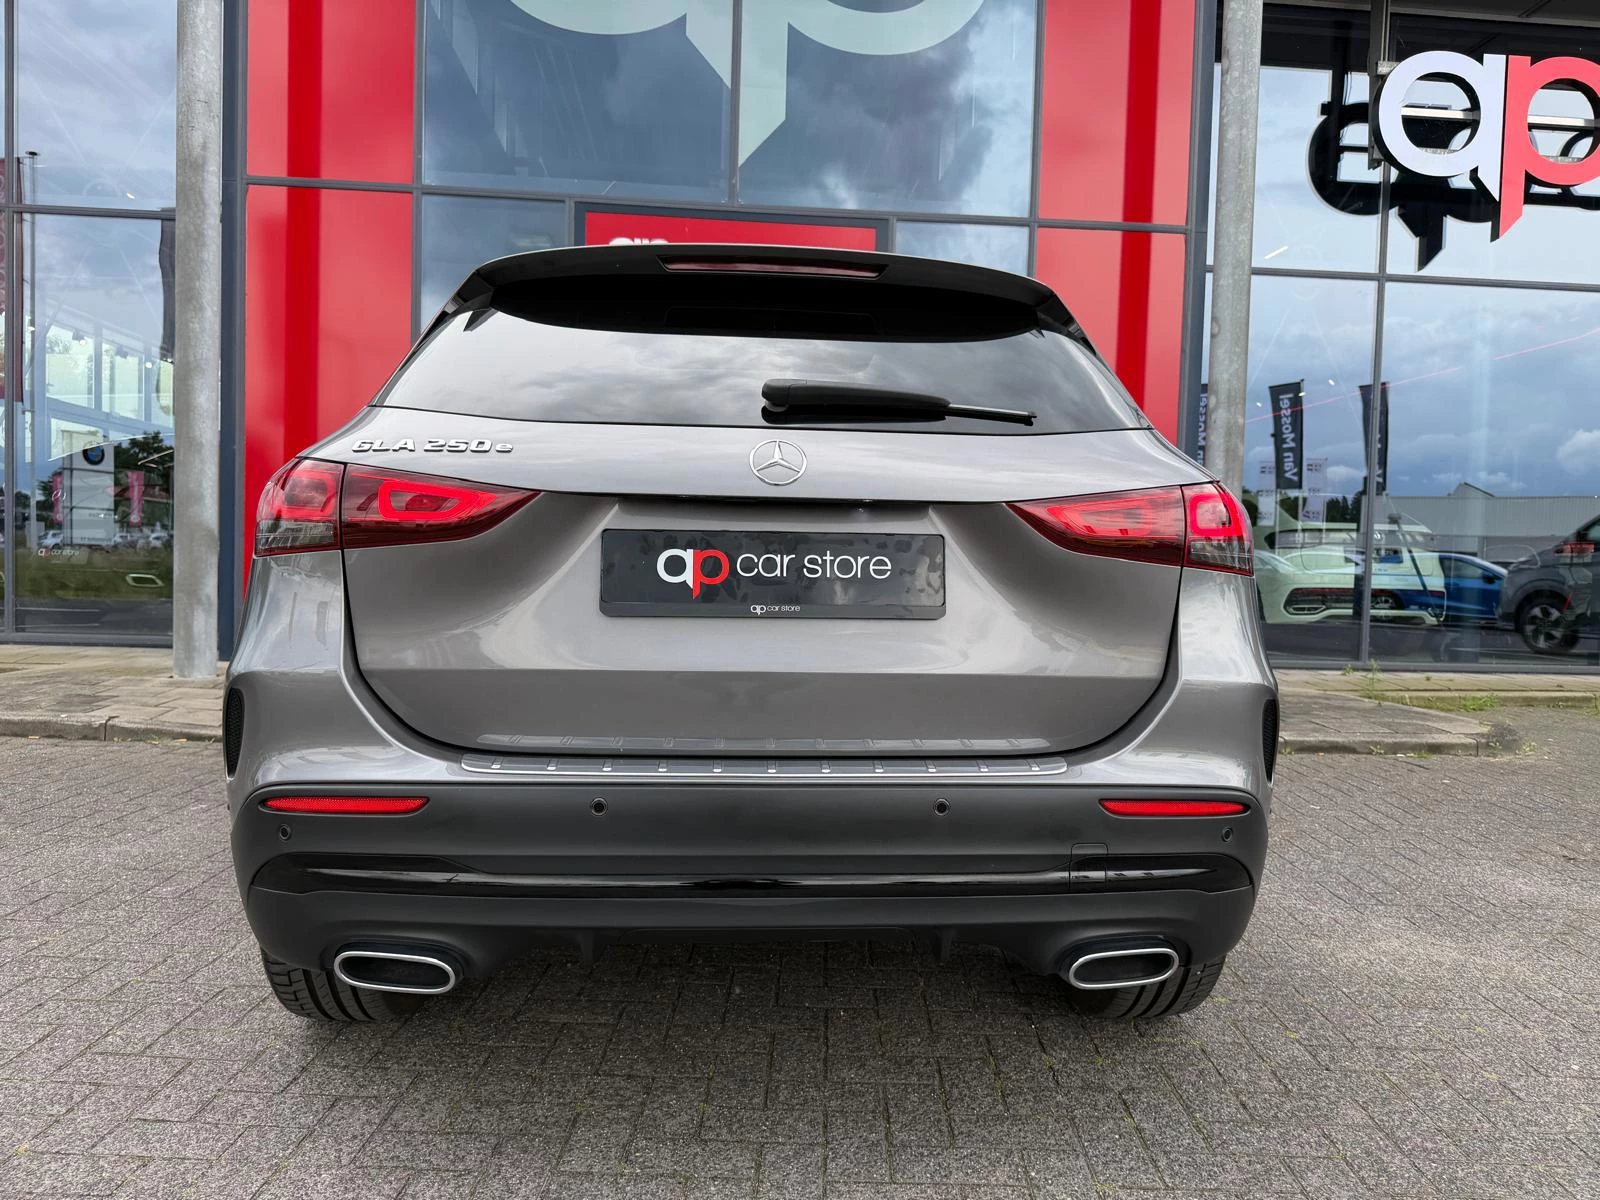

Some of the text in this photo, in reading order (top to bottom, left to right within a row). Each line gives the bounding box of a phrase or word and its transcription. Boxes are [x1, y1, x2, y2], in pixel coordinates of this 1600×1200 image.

[351, 438, 416, 453] GLA
[656, 548, 893, 600] ap car store
[750, 604, 767, 615] ap
[781, 604, 801, 612] store
